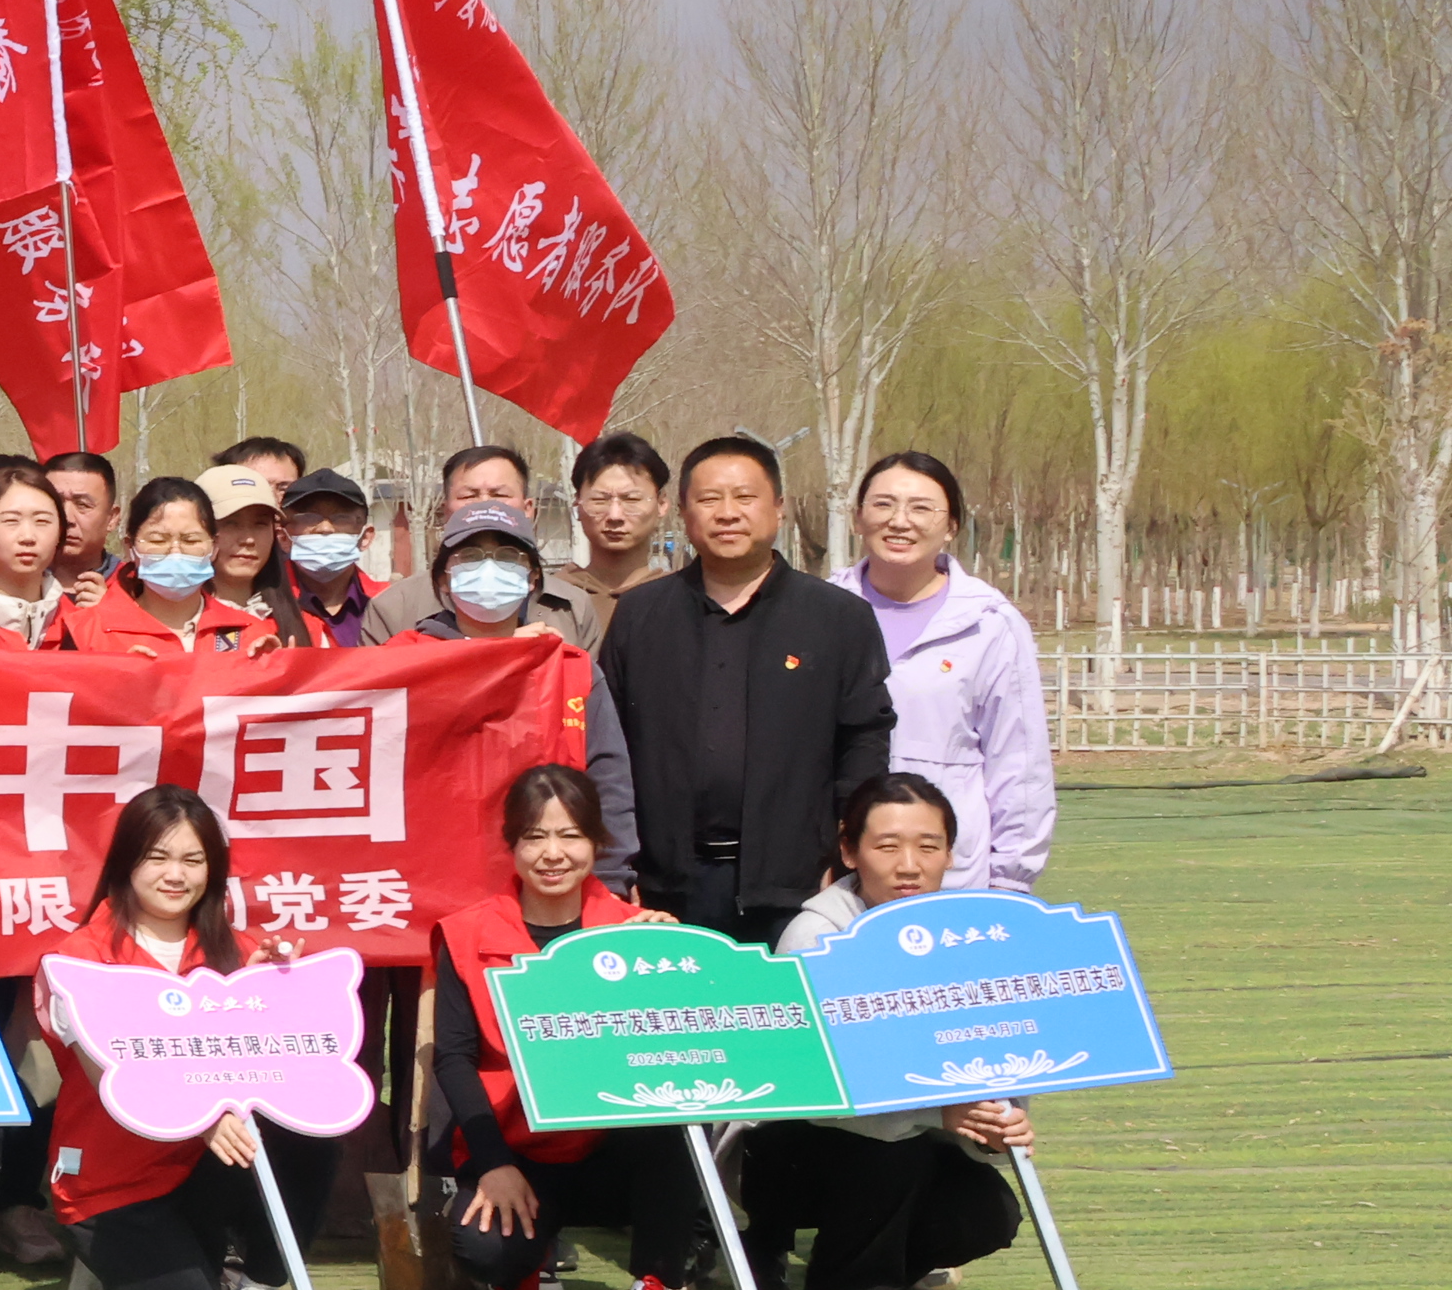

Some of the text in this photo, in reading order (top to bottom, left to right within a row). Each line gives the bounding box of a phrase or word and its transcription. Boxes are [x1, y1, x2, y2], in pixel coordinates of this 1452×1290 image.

[939, 923, 1011, 949] 企业林
[632, 955, 702, 976] 企业林
[199, 995, 269, 1013] 企业林
[820, 963, 1124, 1026] 宁夏德坤环保科技实业集团有限公司团支部
[519, 1002, 811, 1042] 宁夏房地产开发集团有限公司团总支
[934, 1019, 1038, 1046] 2024年4月7日
[109, 1031, 340, 1061] 宁夏第五建筑有限公司团委
[627, 1048, 727, 1068] 2024年4月7日
[185, 1070, 285, 1085] 2024年4月7日
